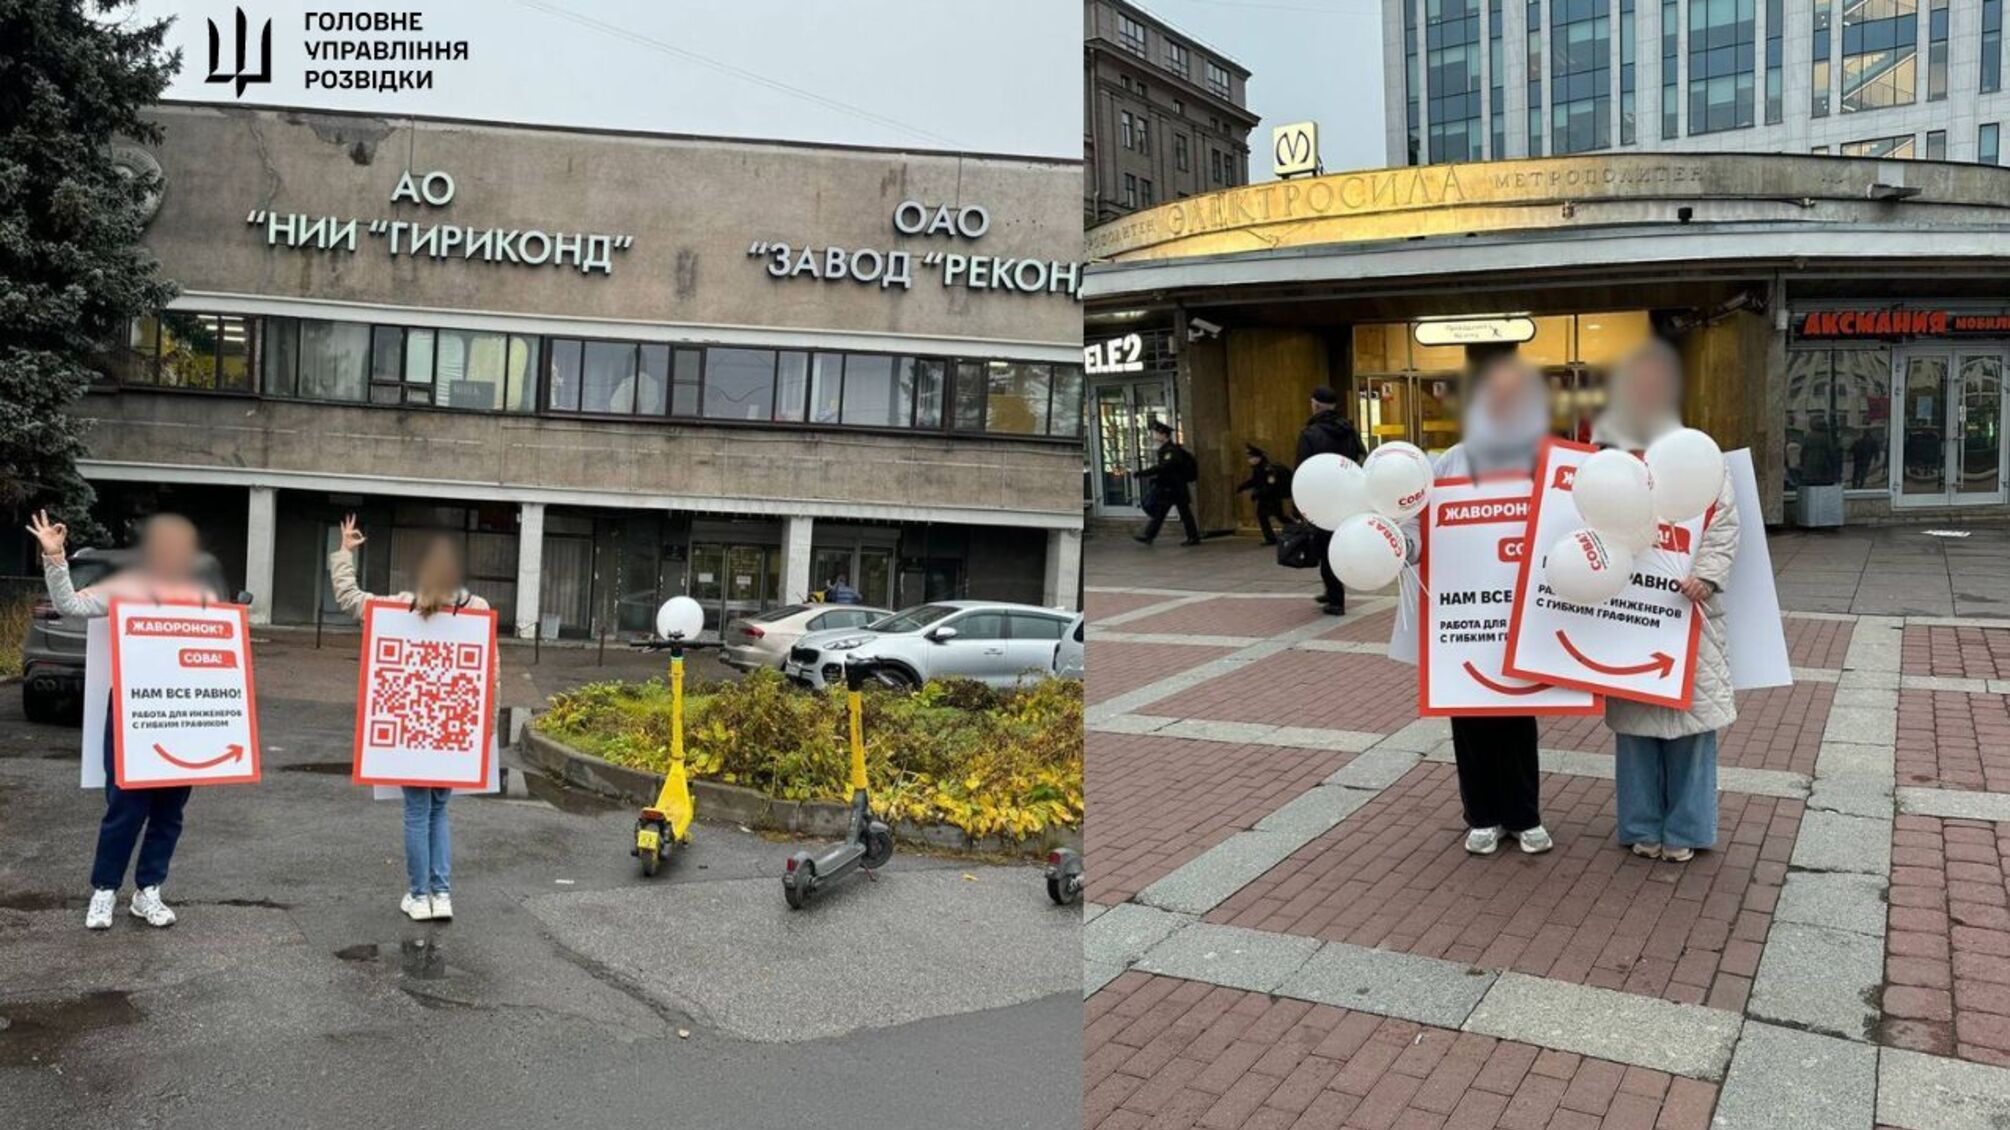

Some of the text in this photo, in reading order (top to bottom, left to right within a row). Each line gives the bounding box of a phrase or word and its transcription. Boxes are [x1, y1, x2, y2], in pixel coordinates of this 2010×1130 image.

[390, 169, 456, 206] АО
[1167, 163, 1466, 235] ЭЛЕКТРОСИЛА
[893, 200, 990, 238] ОАО
[1803, 309, 1948, 335] АКСМАНИЯ
[1445, 502, 1530, 521] ЖАВОРОН
[1629, 572, 1686, 594] АВНО
[1439, 590, 1513, 605] НАМ ВСЕ
[1535, 598, 1661, 628] С ГИБКИМ ГРАФИКОМ
[1609, 598, 1682, 618] ИНЖЕНЕРОВ
[132, 620, 225, 635] ЖАВОРОНОК?
[1440, 619, 1507, 630] РАБОТА ДЛЯ
[1440, 634, 1448, 643] С
[1450, 633, 1496, 643] ГИБКИМ
[183, 652, 222, 664] СОВА!
[131, 687, 242, 699] НАМ ВСЕ РАВНО!
[132, 711, 167, 719] РАБОТА
[189, 709, 242, 718] ИНЖЕНЕРОВ
[141, 720, 179, 729] ГИБКИМ
[180, 720, 229, 728] ГРАФИКОМ
